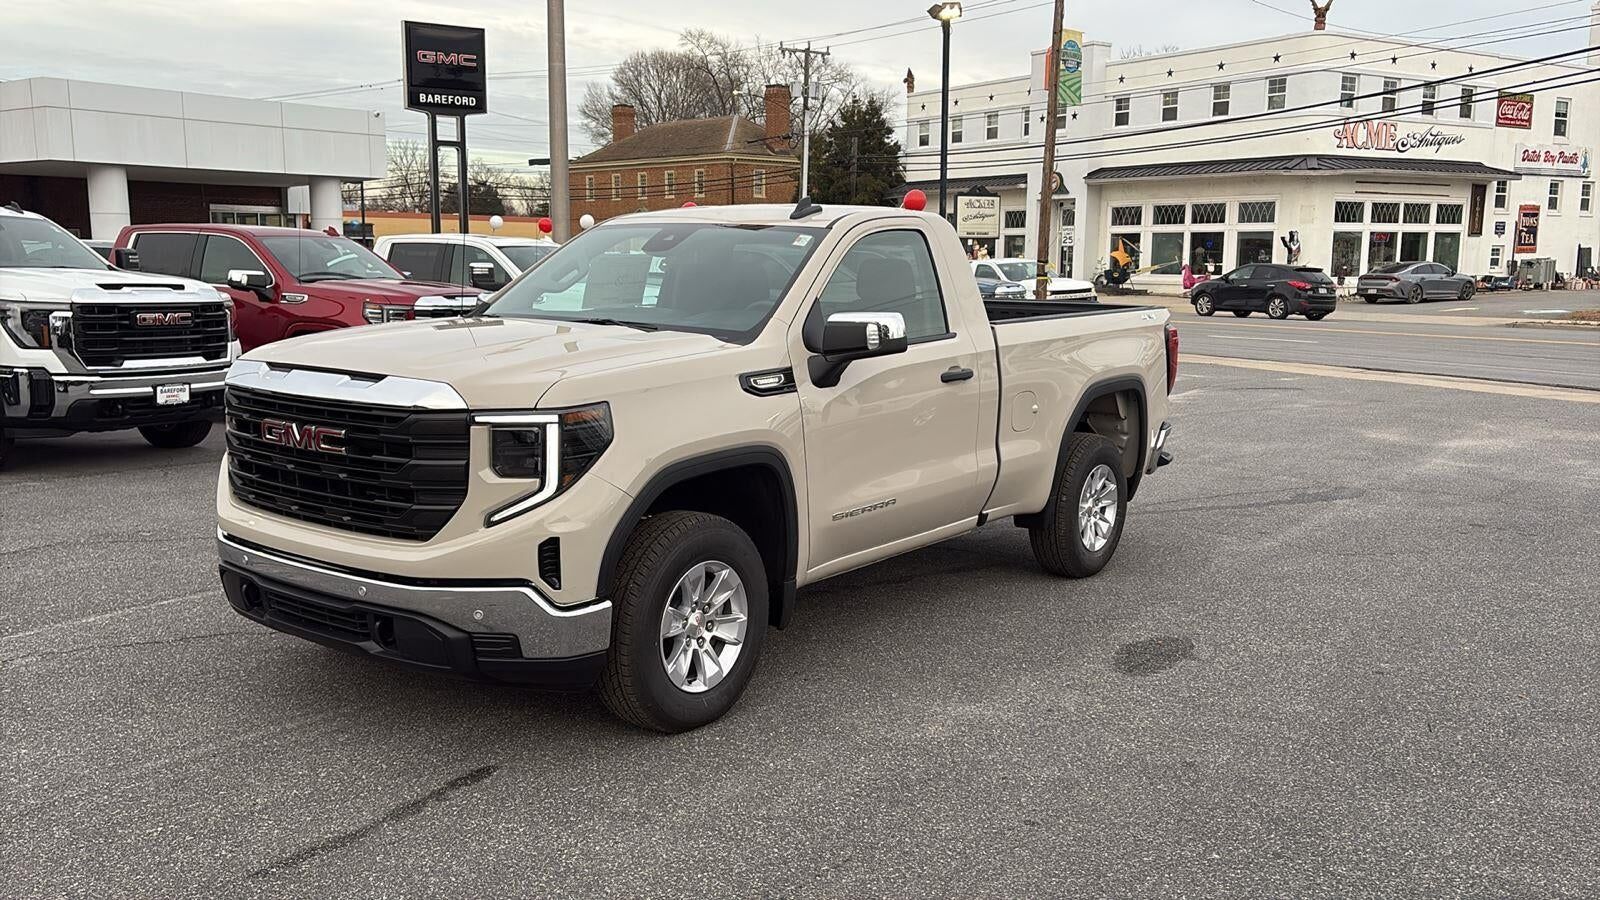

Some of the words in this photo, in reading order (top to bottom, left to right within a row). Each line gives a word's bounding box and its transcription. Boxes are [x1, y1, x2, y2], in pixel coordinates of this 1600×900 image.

[416, 50, 477, 67] GMC
[419, 93, 477, 106] BAREFORD
[1334, 120, 1397, 151] ACME
[1396, 125, 1465, 153] Antiques
[1521, 149, 1541, 162] Dutch
[1543, 150, 1557, 165] Boy
[1557, 151, 1579, 165] Paints
[1062, 236, 1073, 244] 25
[1521, 232, 1534, 243] TEA
[136, 312, 192, 325] GMC
[261, 418, 347, 455] GMC
[832, 498, 897, 521] SIERRA
